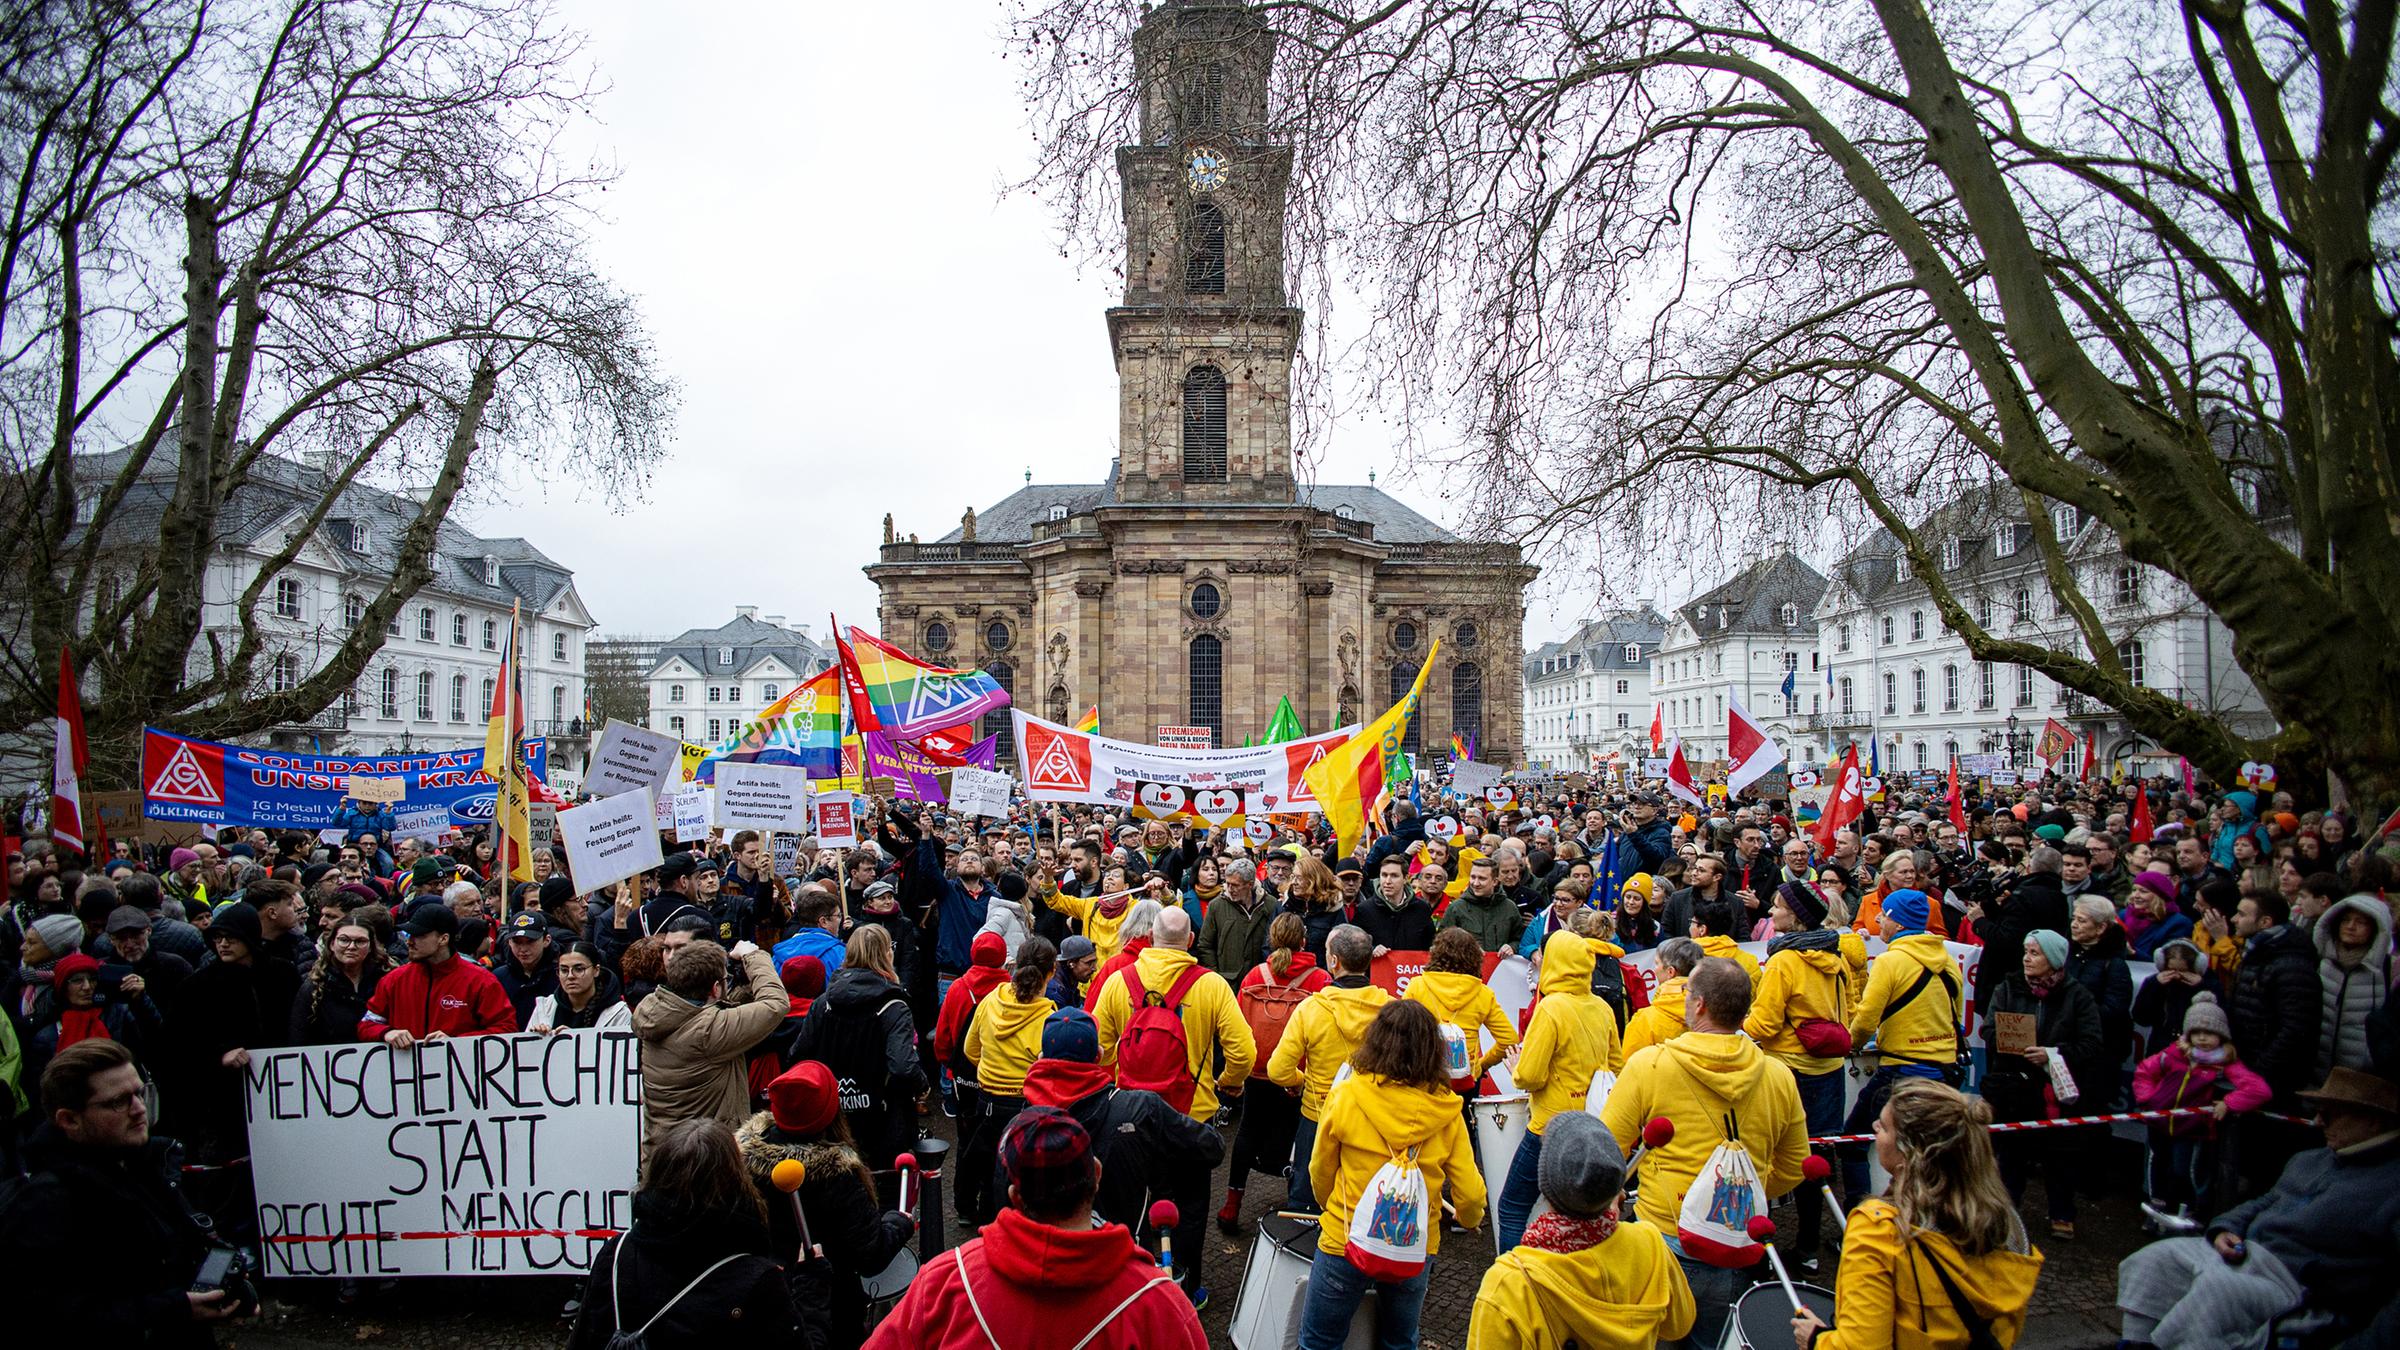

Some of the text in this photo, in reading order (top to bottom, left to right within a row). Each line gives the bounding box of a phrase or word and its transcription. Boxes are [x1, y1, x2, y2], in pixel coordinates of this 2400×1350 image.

[1159, 727, 1210, 736] EXTREMISMUS
[621, 737, 658, 753] Antifa heißt:
[238, 752, 477, 774] SOLIDARITÄT
[619, 749, 649, 763] Gegen die
[603, 757, 658, 777] Verarmungspolitik
[1113, 766, 1139, 779] Doch
[1140, 770, 1150, 780] in
[1151, 772, 1181, 783] unser
[1224, 768, 1267, 783] gehören
[604, 771, 649, 788] der Regierung!
[736, 779, 759, 787] Antifa
[727, 789, 791, 800] Gegen deutschen
[252, 801, 271, 811] IG
[276, 802, 321, 814] Metall
[725, 800, 777, 809] Nationalismus
[1145, 800, 1178, 810] DEMOKRATIE
[252, 811, 287, 822] Ford
[589, 814, 633, 833] Antifa heißt:
[731, 811, 786, 821] Militarisierung!
[585, 825, 641, 849] Festung Europa
[599, 840, 634, 858] einreißen!
[243, 1031, 643, 1124] MENSCHENRECHTE
[387, 1113, 548, 1195] STATT
[259, 1199, 402, 1276] RECHTE
